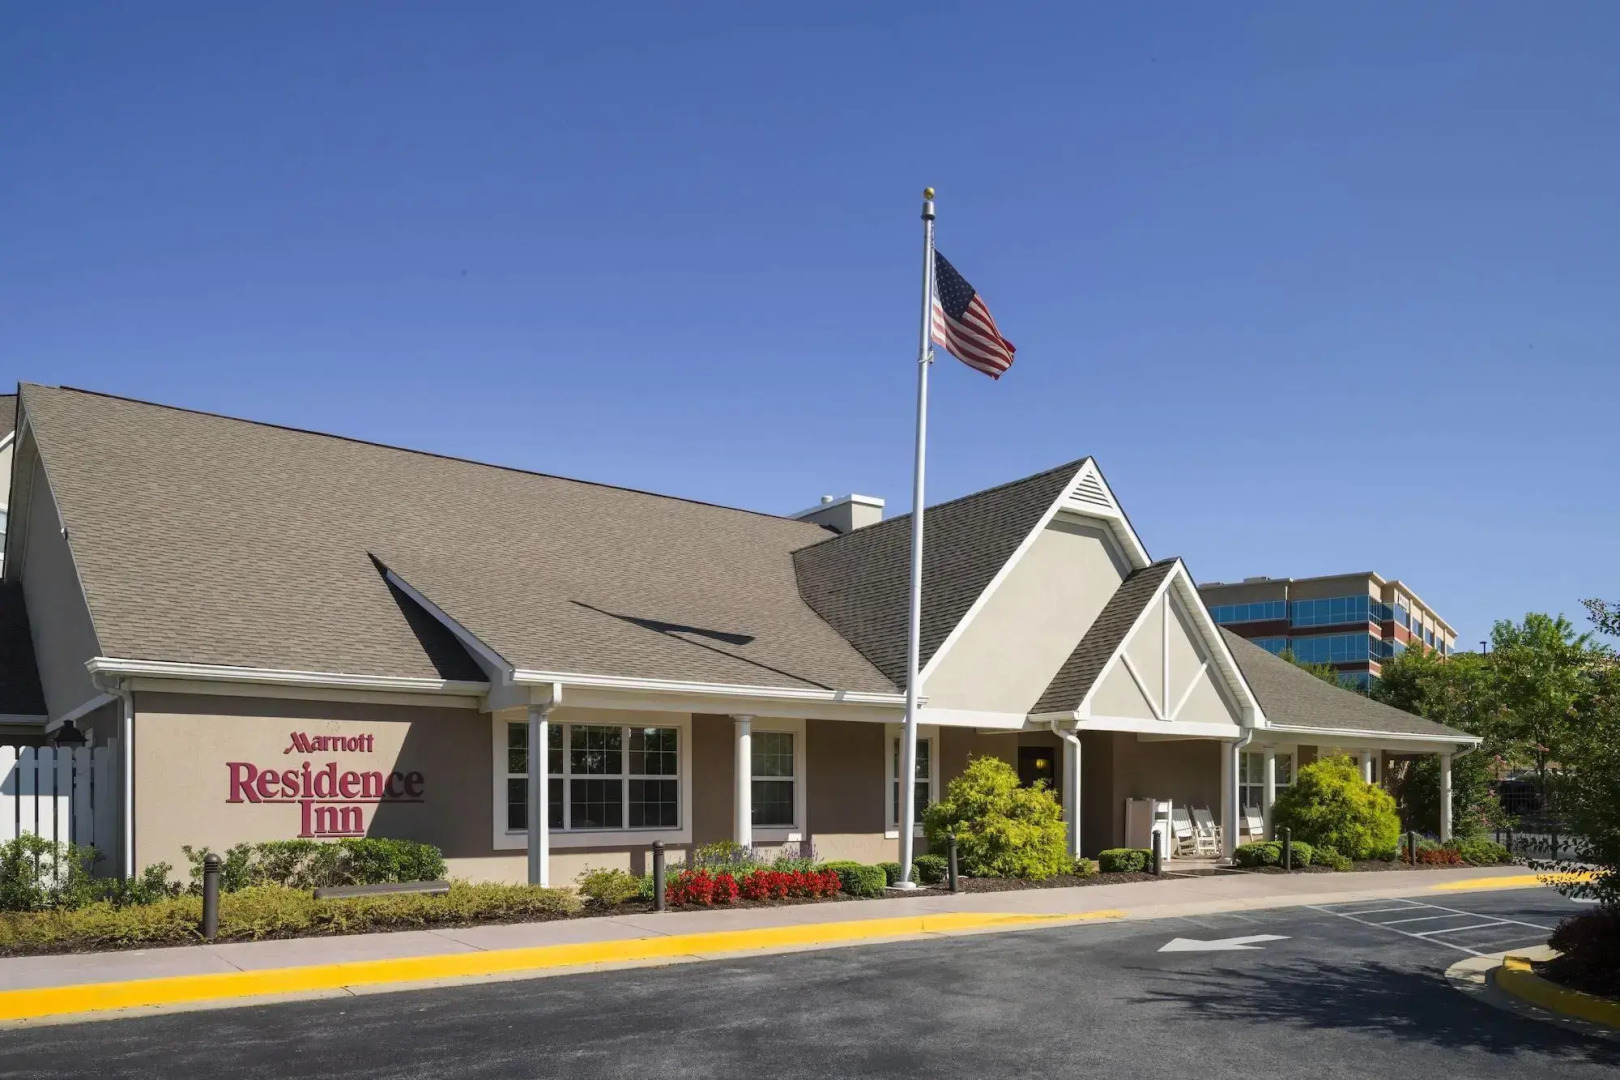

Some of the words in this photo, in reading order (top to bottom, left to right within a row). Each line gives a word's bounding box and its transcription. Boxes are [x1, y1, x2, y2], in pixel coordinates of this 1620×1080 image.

[283, 731, 374, 754] Marriott
[226, 761, 424, 803] Residence
[297, 799, 365, 838] Inn
